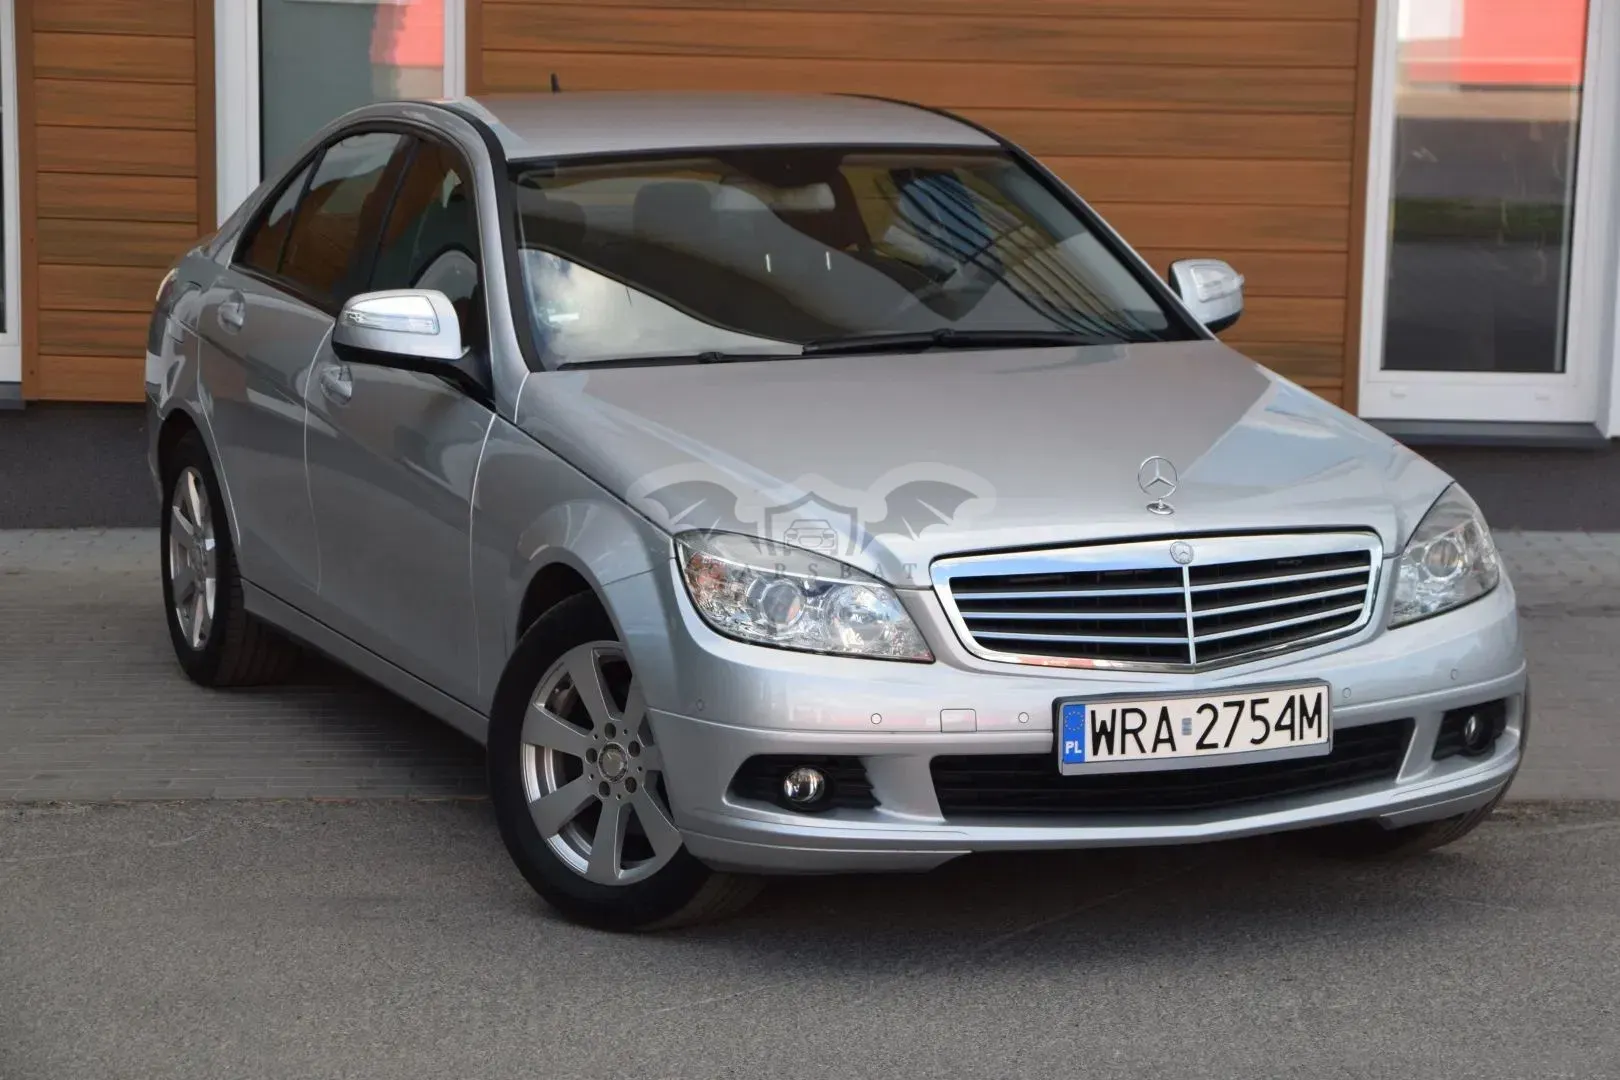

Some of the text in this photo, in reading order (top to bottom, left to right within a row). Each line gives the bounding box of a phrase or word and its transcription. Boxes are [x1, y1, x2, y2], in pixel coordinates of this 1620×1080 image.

[1090, 692, 1322, 756] WRA 2754M
[1065, 740, 1082, 754] PL
